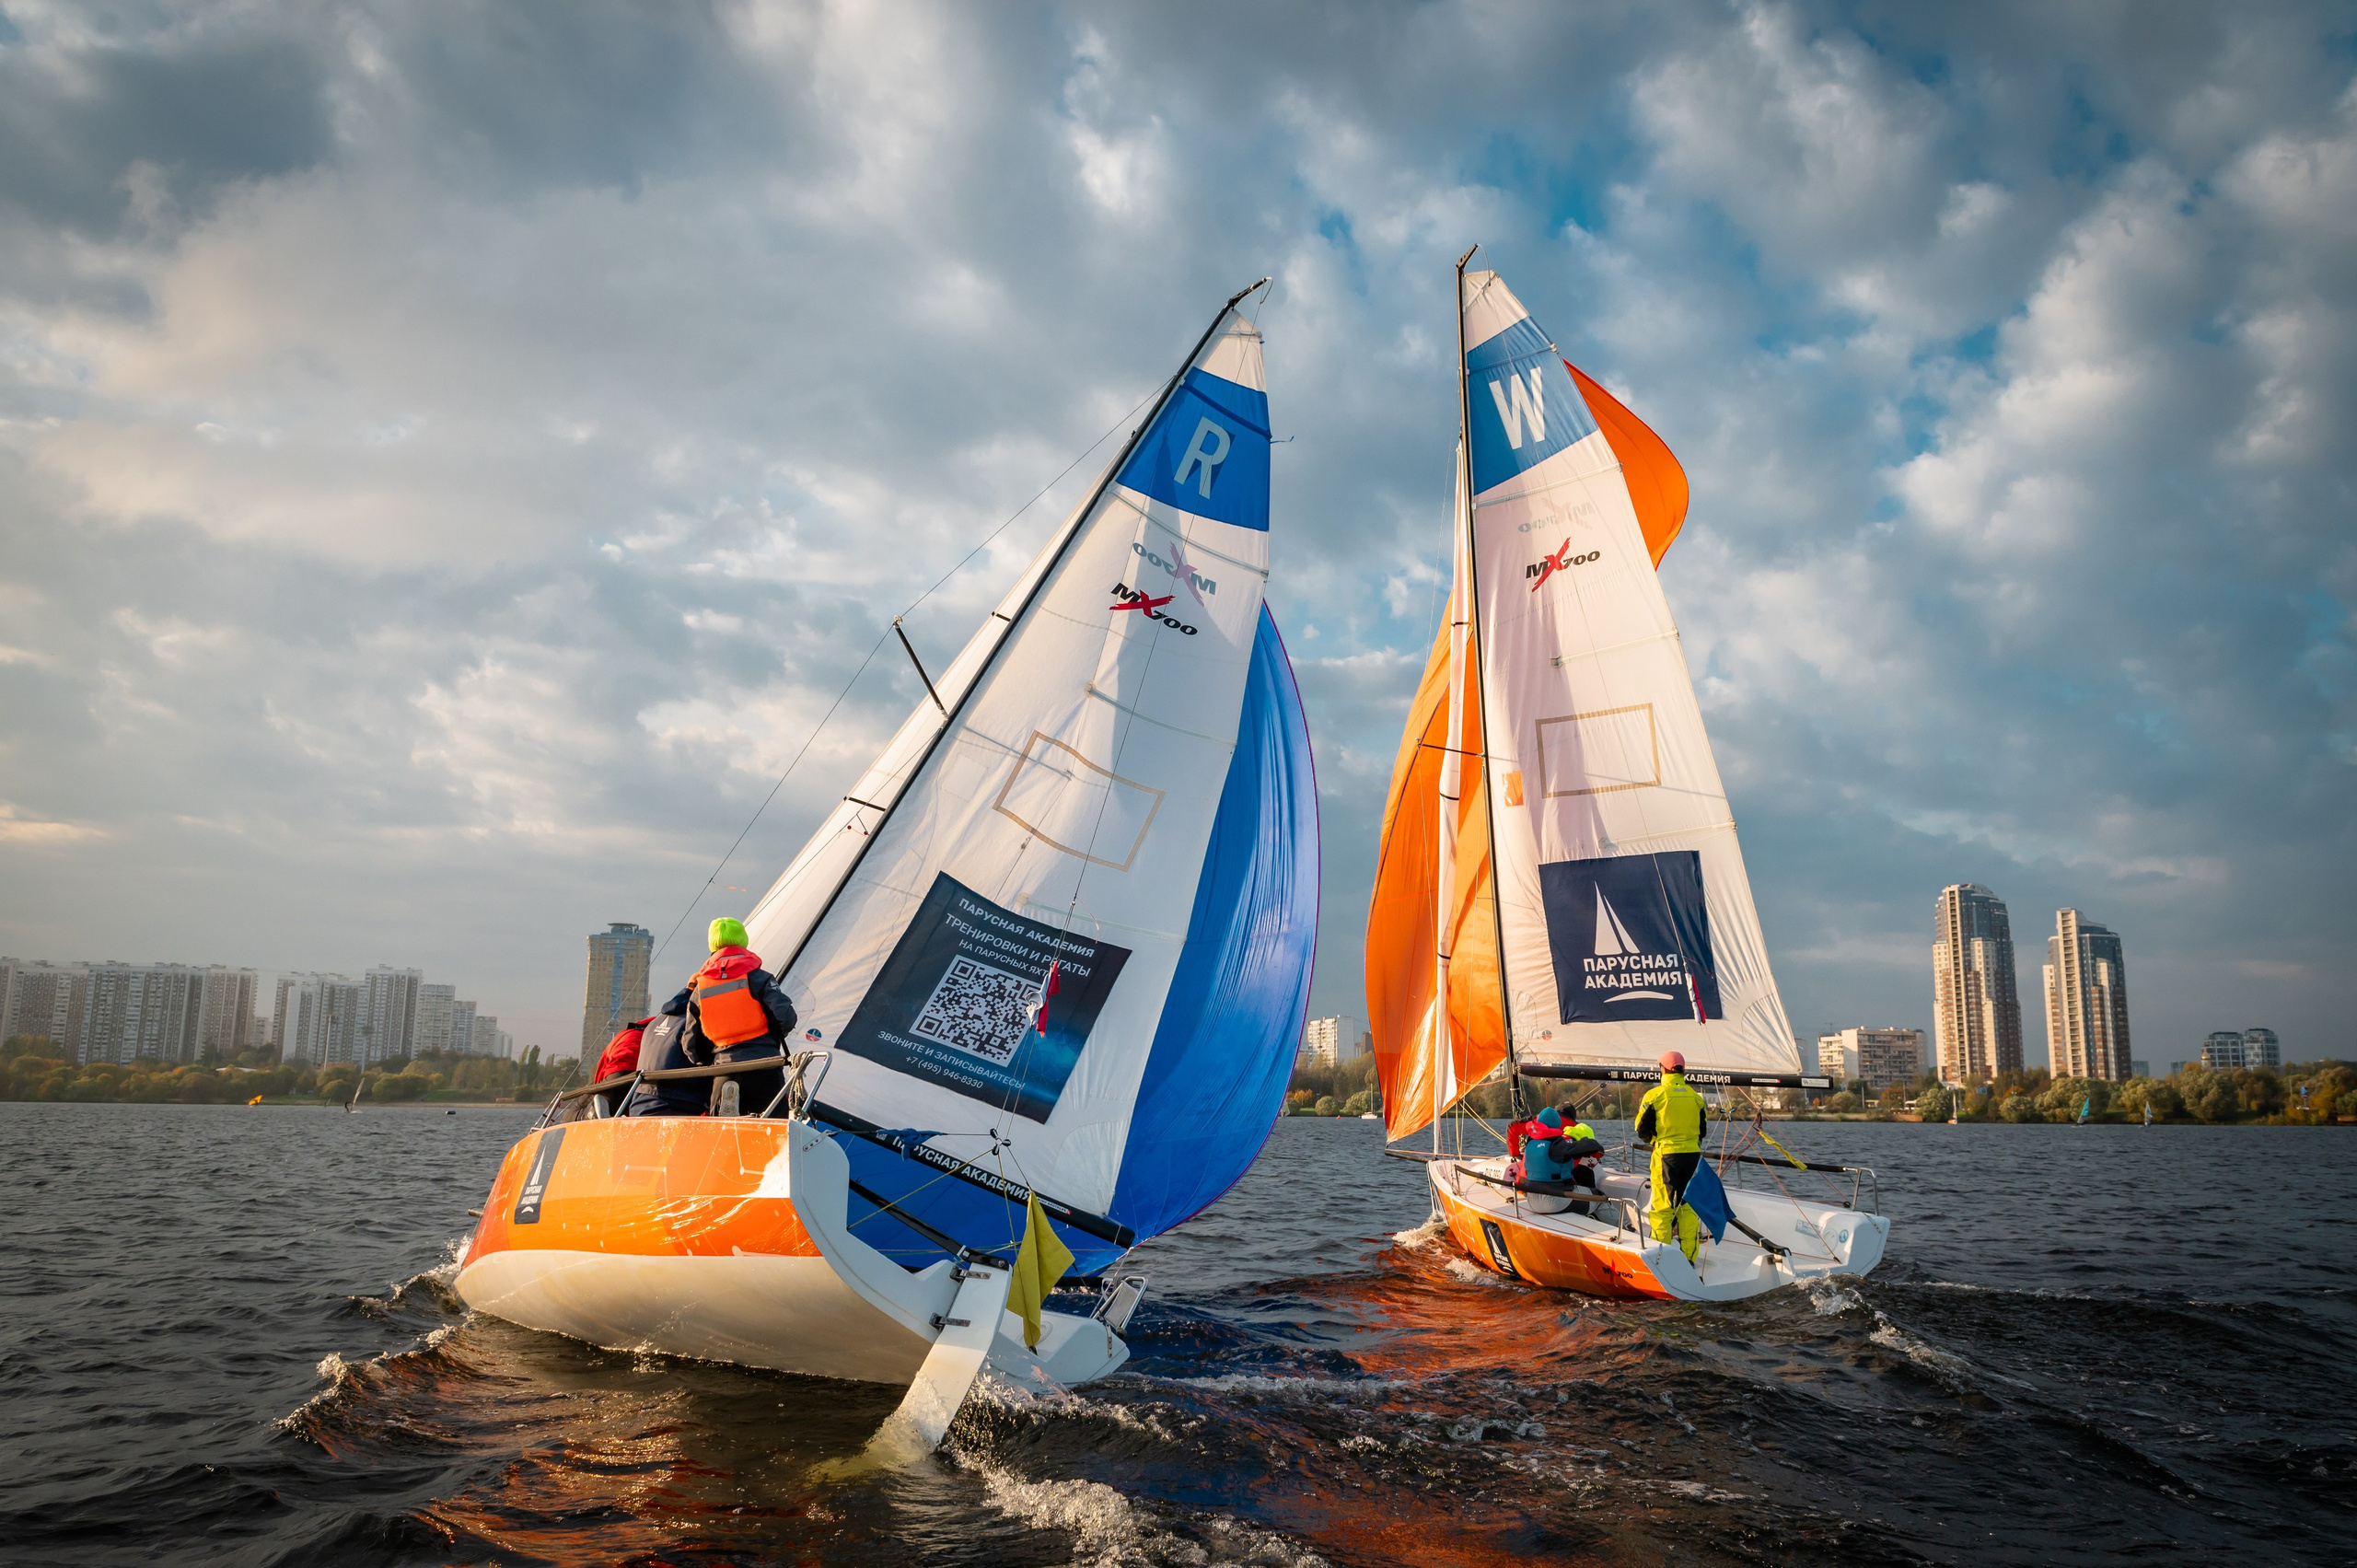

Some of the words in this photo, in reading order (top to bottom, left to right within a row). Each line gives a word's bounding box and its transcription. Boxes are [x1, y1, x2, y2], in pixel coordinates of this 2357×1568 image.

[1489, 366, 1545, 449] W
[1173, 416, 1232, 500] R
[1525, 537, 1600, 593] MX700
[1109, 583, 1198, 636] MX700
[946, 913, 1029, 958] ТРЕНИРОВКИ
[1029, 949, 1040, 961] И
[958, 898, 1025, 935] ПАРУСНАЯ
[1026, 930, 1095, 958] АКАДЕМИЯ
[958, 939, 973, 951] НА
[975, 946, 1028, 971] ПАРУСНЫХ
[1029, 965, 1060, 979] ЯХТ
[1583, 953, 1679, 972] ПАРУСНАЯ
[1585, 970, 1683, 990] АКАДЕМИЯ
[877, 1030, 925, 1053] ЗВОНИТЕ
[924, 1048, 934, 1056] И
[934, 1051, 1026, 1089] ЗАПИСЫВАЙТЕСЬ!
[905, 1055, 918, 1064] +7
[918, 1058, 942, 1075] (495)
[943, 1068, 984, 1089] 946-8330
[1623, 1071, 1661, 1081] ПАРУСН
[1684, 1073, 1731, 1084] КАДЕМИЯ
[961, 1165, 1030, 1202] АКАДЕМИЯ
